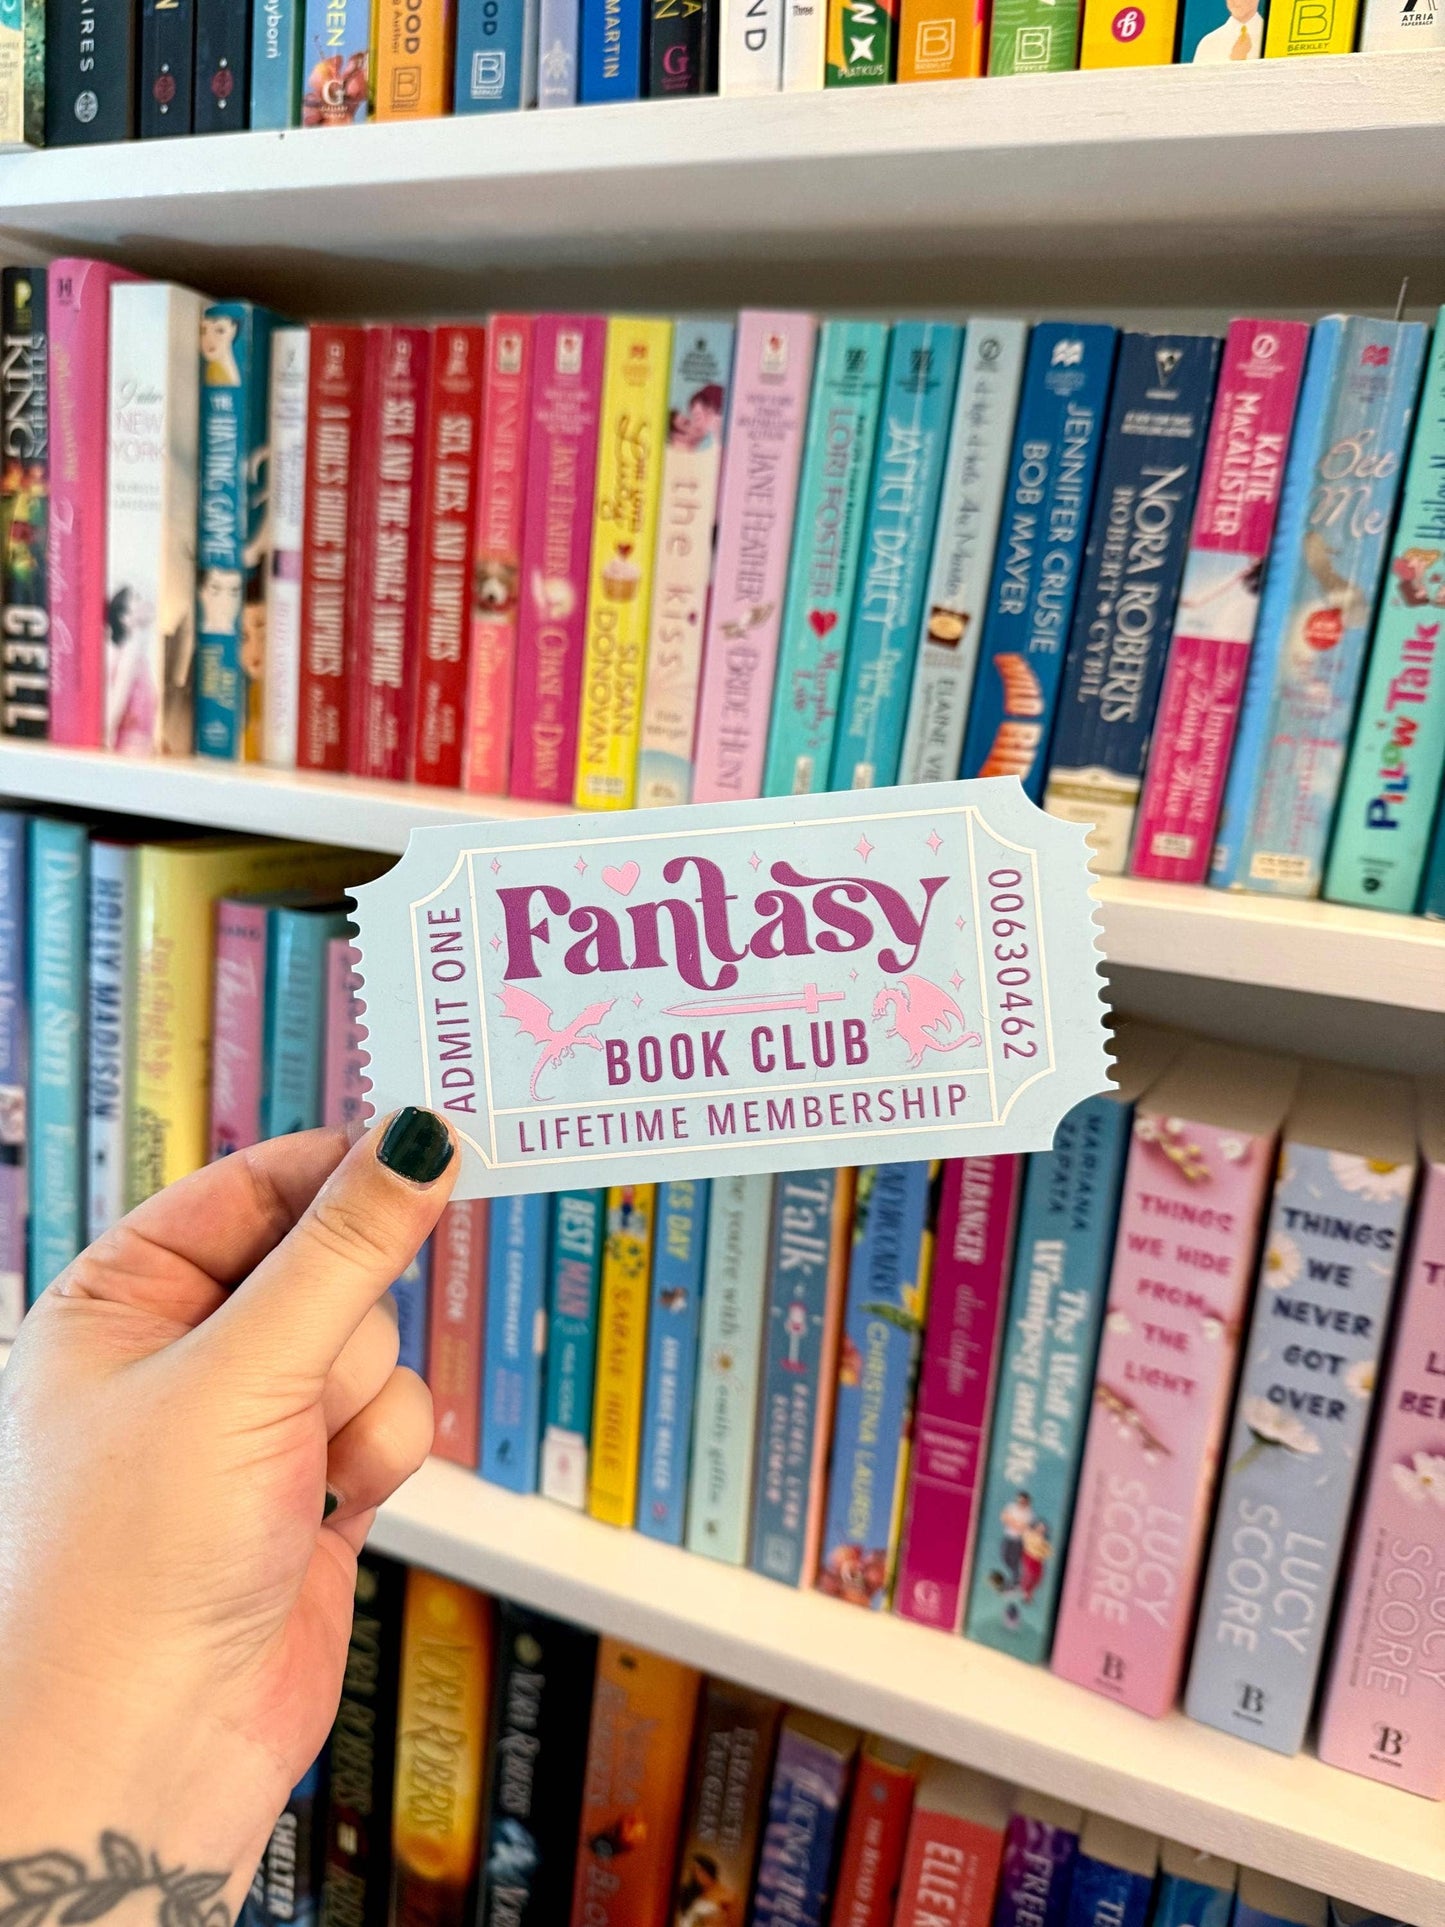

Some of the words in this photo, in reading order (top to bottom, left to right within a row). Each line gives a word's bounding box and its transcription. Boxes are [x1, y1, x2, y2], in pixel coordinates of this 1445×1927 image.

[80, 0, 95, 72] IRES
[602, 0, 621, 79] MARTIN
[1287, 42, 1329, 52] BERKLEY
[1401, 13, 1434, 22] ATRIA
[3, 333, 35, 458] KING
[824, 407, 856, 479] LORI
[1015, 441, 1050, 505] BOB
[1048, 401, 1095, 542] JENNIFER
[1242, 431, 1283, 505] KATIE
[668, 481, 701, 557] the
[1125, 464, 1189, 576] NORA
[997, 513, 1038, 615] MAYER
[1028, 549, 1074, 655] CRUSIE
[5, 604, 49, 730] CELL
[586, 607, 618, 765] DONOVAN
[612, 643, 640, 737] SUSAN
[1100, 580, 1162, 723] ROBERTS
[1384, 621, 1441, 713] Talk
[91, 878, 122, 973] HOLLY
[428, 907, 465, 983] ONE
[497, 857, 946, 990] Fantasy
[989, 868, 1037, 1060] 00630462
[90, 982, 121, 1121] MADISON
[439, 1000, 476, 1114] ADMIT
[606, 1031, 727, 1086] BOOK
[752, 1019, 868, 1073] CLUB
[519, 1106, 686, 1153] LIFETIME
[708, 1085, 964, 1142] MEMBERSHIP
[1048, 1119, 1077, 1217] ZAPATA
[1070, 1113, 1102, 1232] MARIANA
[557, 1197, 596, 1258] BEST
[666, 1214, 692, 1262] DAY
[779, 1178, 831, 1271] Talk
[1126, 1233, 1164, 1258] WE
[1174, 1245, 1232, 1276] HIDE
[1137, 1193, 1233, 1234] THINGS
[1281, 1206, 1396, 1251] THINGS
[555, 1258, 592, 1321] MAN
[1010, 1239, 1067, 1380] Winnipeg
[1135, 1278, 1206, 1310] FROM
[1306, 1257, 1353, 1288] WE
[608, 1284, 630, 1377] SARAH
[1050, 1289, 1091, 1345] The
[1140, 1322, 1190, 1352] THE
[1271, 1296, 1374, 1338] NEVER
[859, 1322, 890, 1445] CHRISTINA
[1043, 1350, 1082, 1420] Wall
[1123, 1360, 1198, 1397] LIGHT
[1281, 1344, 1346, 1376] GOT
[1009, 1380, 1038, 1441] and
[1265, 1384, 1346, 1422] OVER
[847, 1449, 877, 1540] LAUREN
[1088, 1475, 1148, 1625] SCORE
[1135, 1505, 1185, 1629] LUCY
[1216, 1499, 1282, 1652] SCORE
[1270, 1530, 1328, 1655] LUCY
[1366, 1538, 1434, 1697] SCORE
[268, 1811, 298, 1919] SHELTER
[914, 1840, 964, 1912] ELLE
